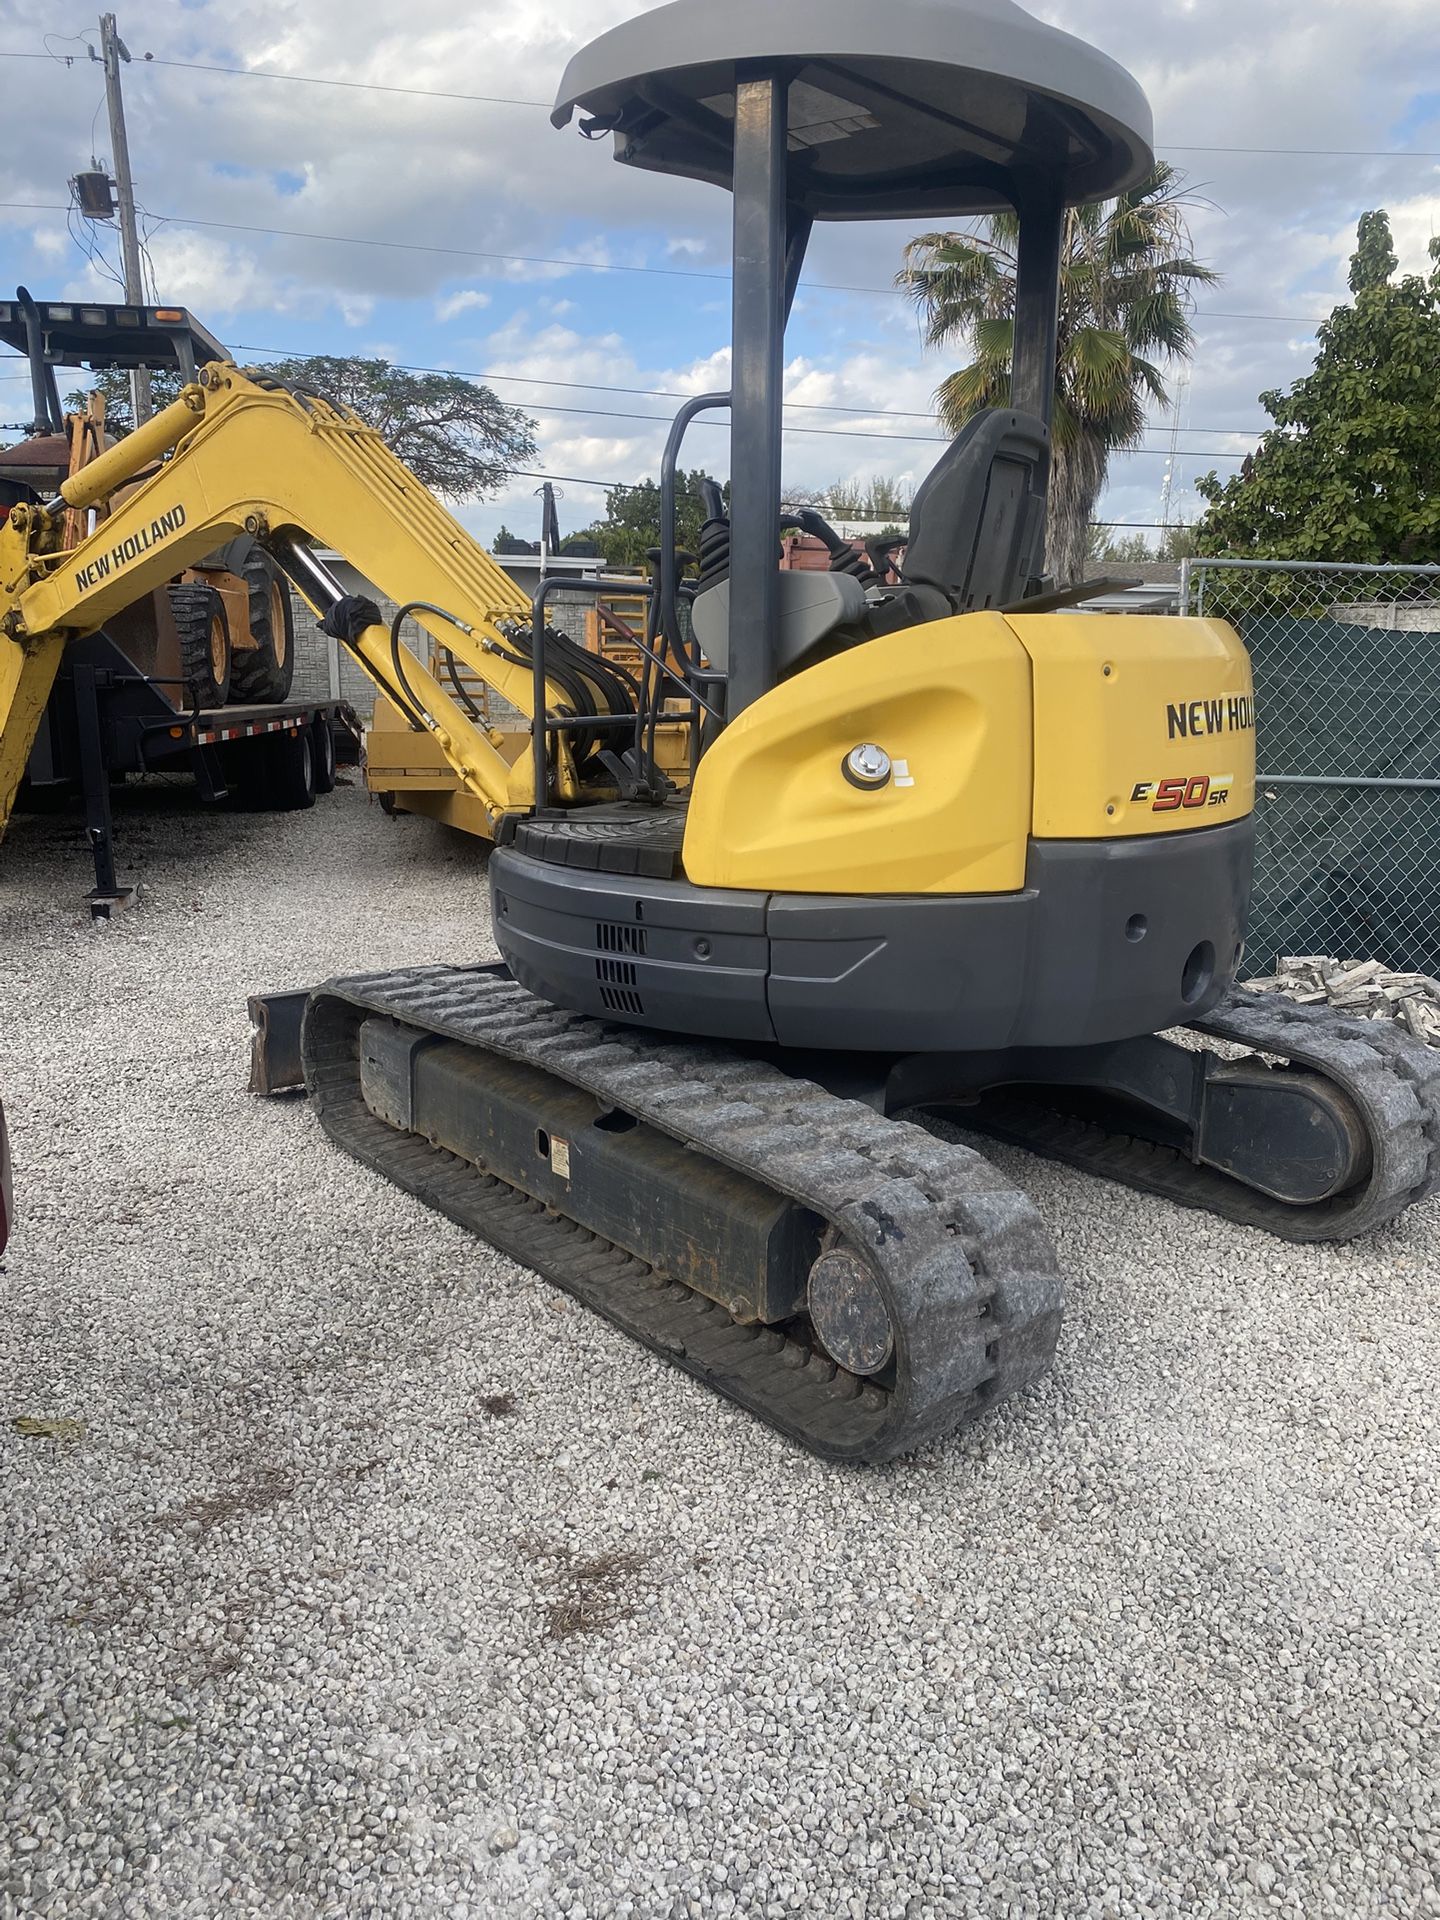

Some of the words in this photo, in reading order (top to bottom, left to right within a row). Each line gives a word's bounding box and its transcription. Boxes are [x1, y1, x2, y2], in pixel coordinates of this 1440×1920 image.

[75, 554, 110, 592] NEW
[111, 504, 186, 569] HOLLAND
[1166, 698, 1223, 739] NEW
